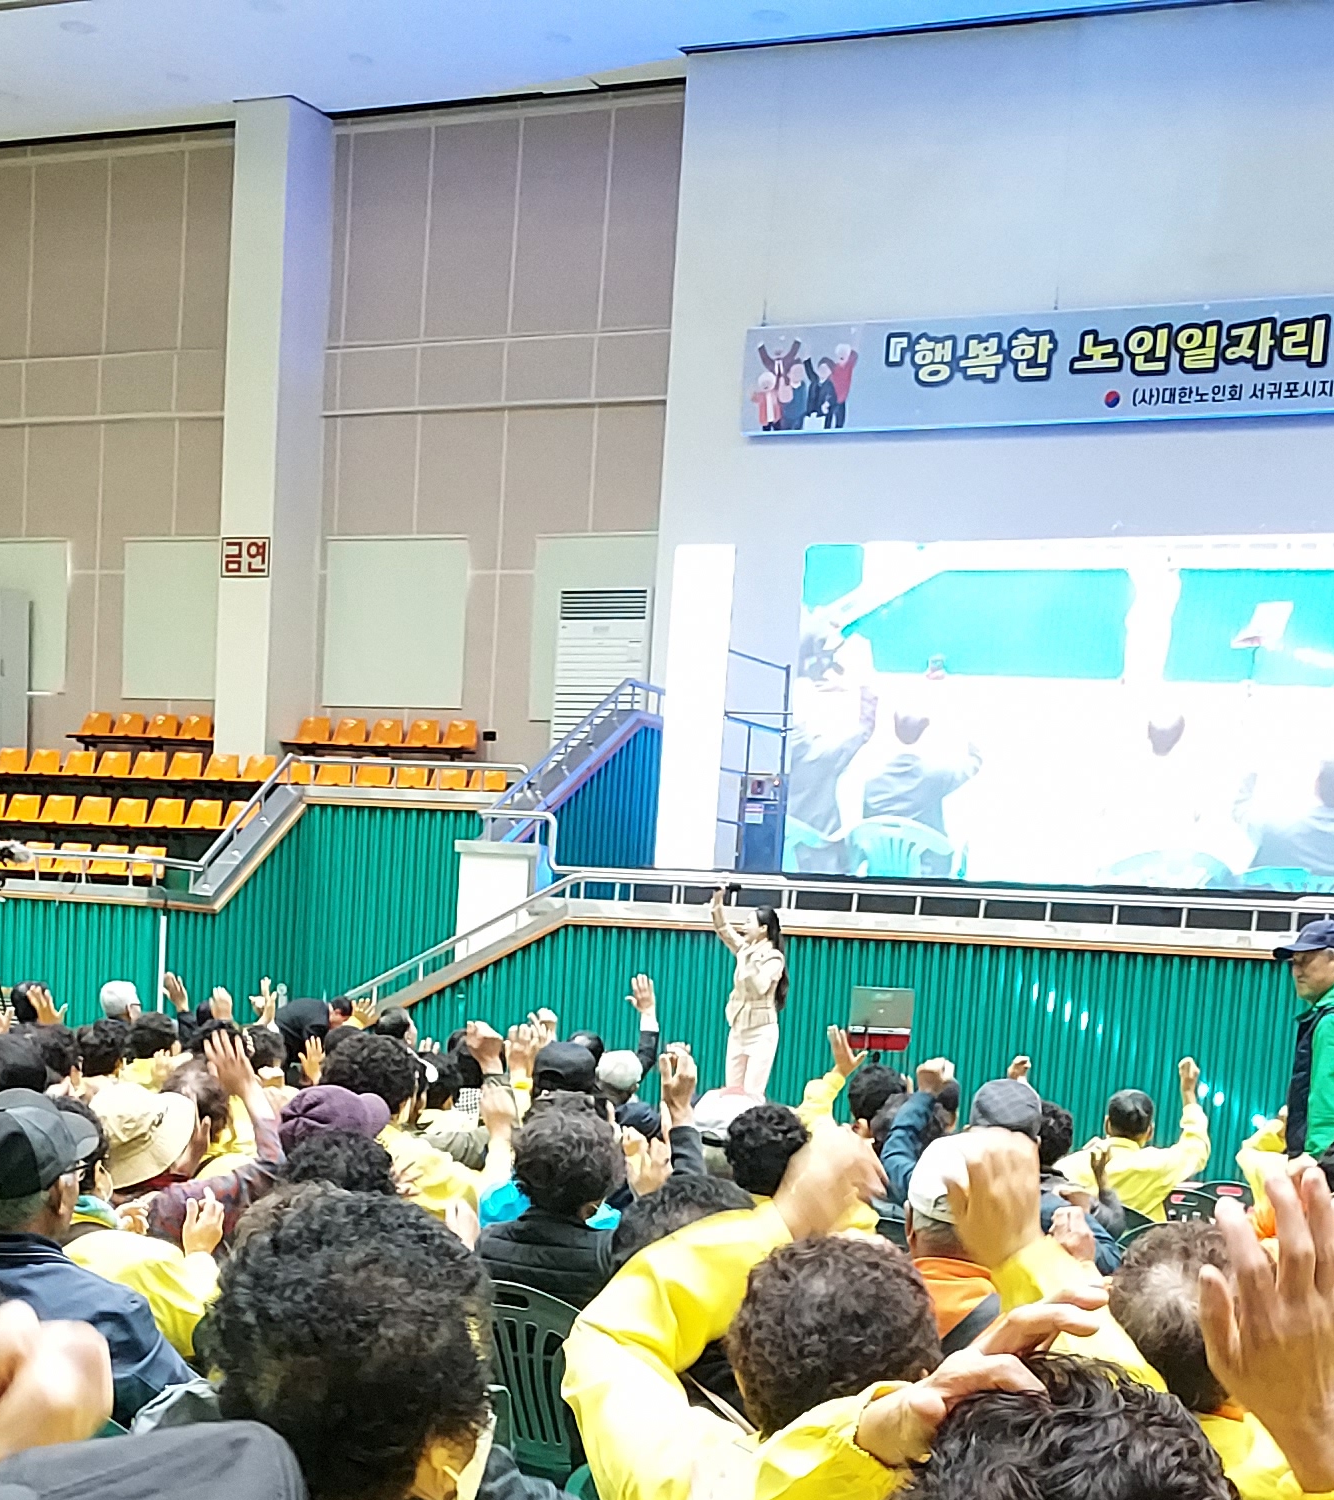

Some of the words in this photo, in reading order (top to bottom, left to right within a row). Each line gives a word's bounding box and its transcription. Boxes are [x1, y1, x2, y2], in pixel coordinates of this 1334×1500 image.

[886, 329, 1056, 386] 『행복한
[1070, 315, 1330, 375] 노인일자리
[1132, 382, 1243, 407] (사)대한노인회
[224, 541, 267, 573] 금연
